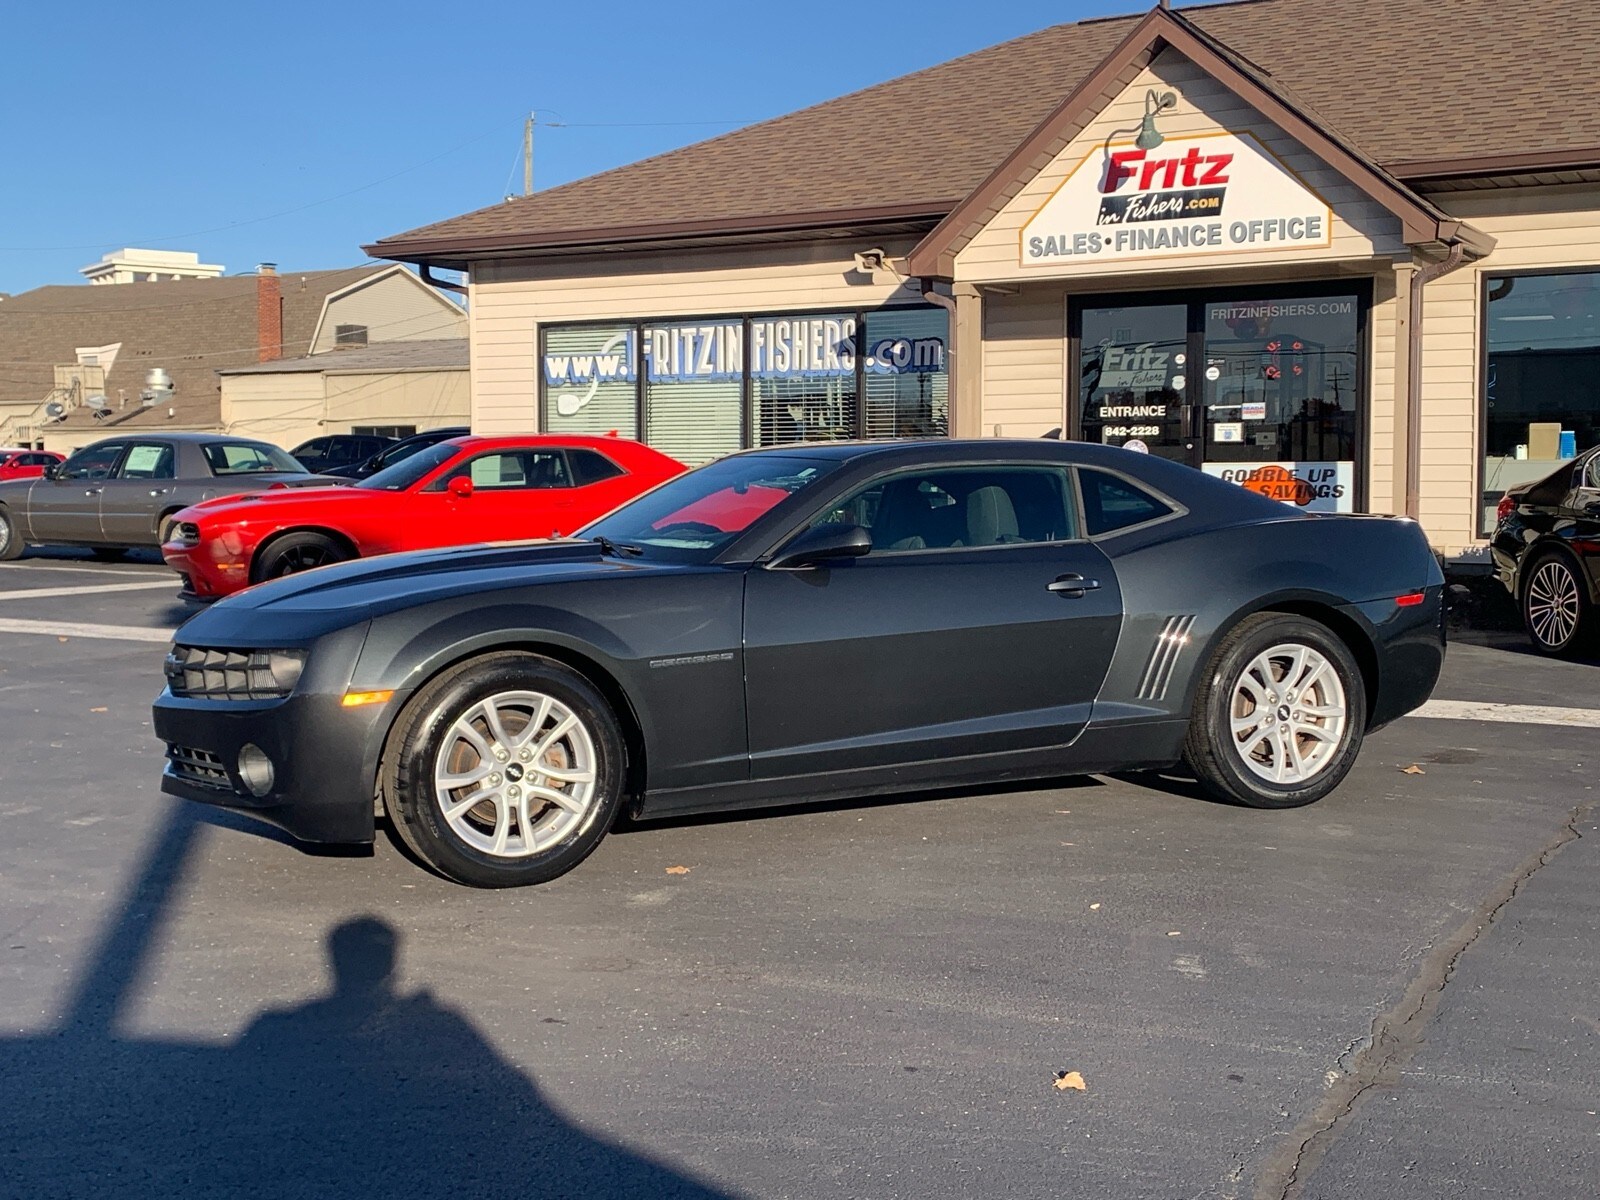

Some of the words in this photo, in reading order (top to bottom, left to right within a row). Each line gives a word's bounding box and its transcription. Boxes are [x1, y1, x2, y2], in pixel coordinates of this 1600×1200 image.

[1103, 147, 1234, 193] Fritz
[1099, 207, 1120, 225] in
[1121, 193, 1183, 222] Fishers
[1028, 232, 1102, 257] SALES
[1115, 223, 1222, 251] FINANCE
[1229, 216, 1322, 243] OFFICE
[1211, 303, 1351, 320] FRITZINFISHERS.COM
[1102, 342, 1170, 371] Fritz
[1100, 405, 1166, 417] ENTRANCE
[1105, 426, 1160, 436] 842-2228
[1221, 469, 1299, 482] GOBBLE
[1307, 468, 1336, 482] UP
[1259, 484, 1345, 498] SAVINGS
